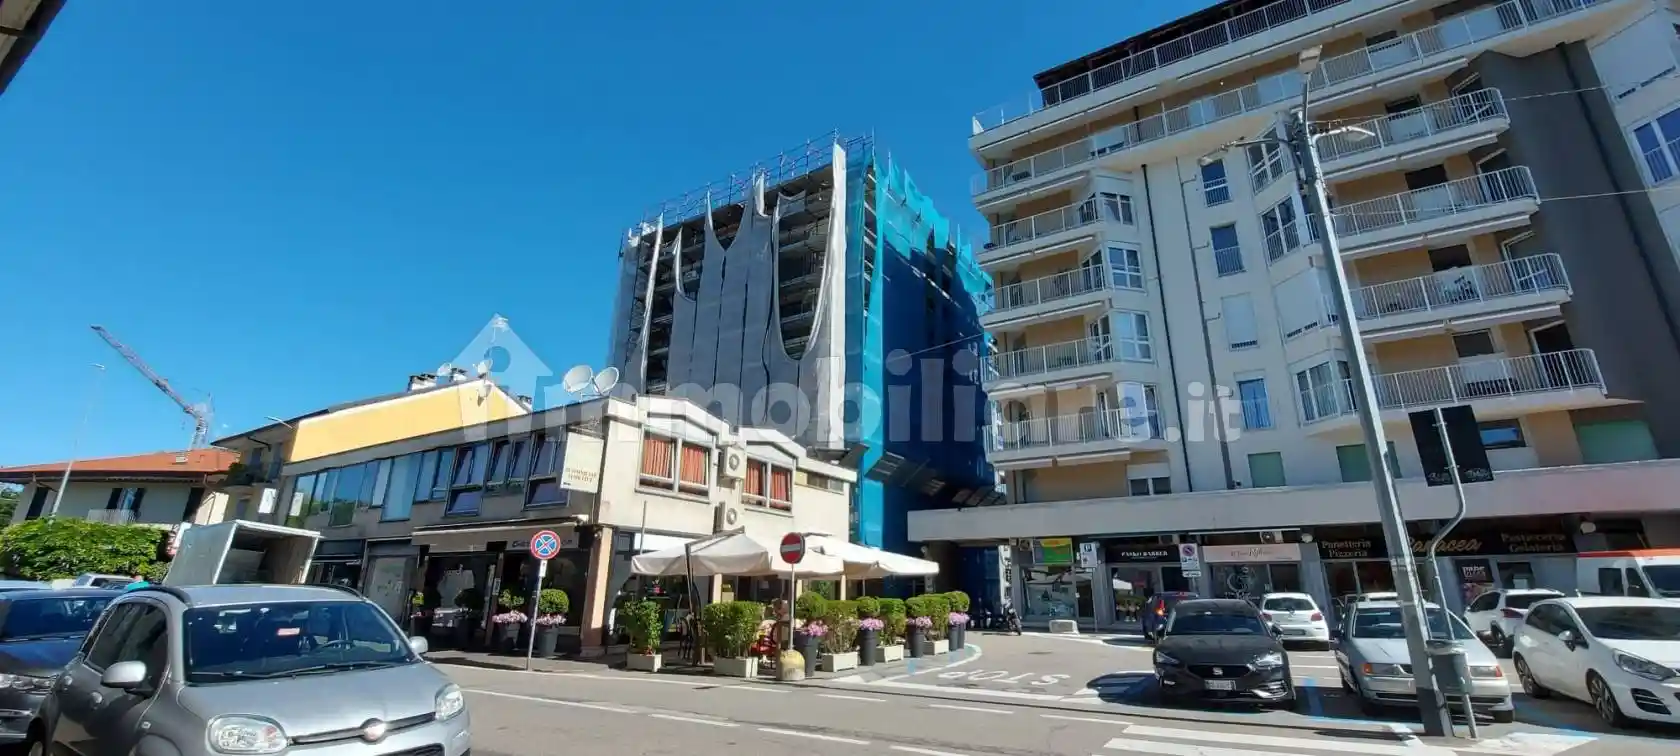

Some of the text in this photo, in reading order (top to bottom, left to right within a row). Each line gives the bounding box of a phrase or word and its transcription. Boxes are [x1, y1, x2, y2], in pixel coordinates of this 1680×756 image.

[1321, 539, 1372, 549] Panetteria
[1329, 548, 1368, 557] Pizzeria
[937, 669, 1071, 685] STOP
